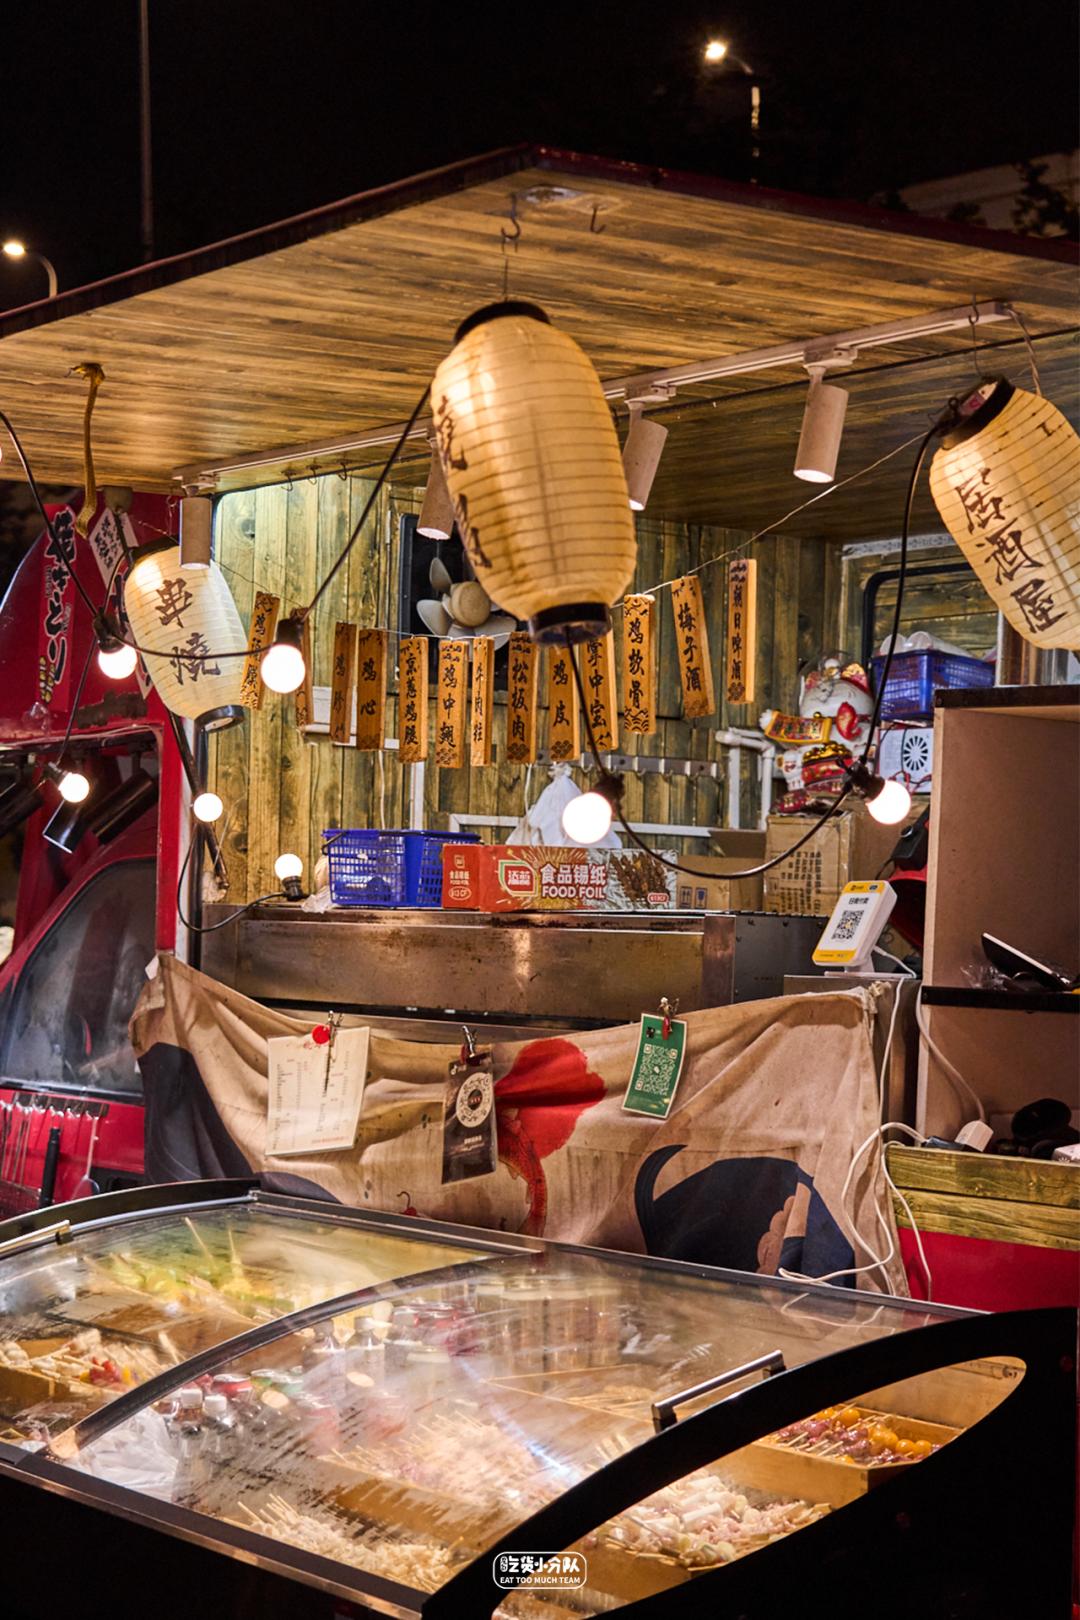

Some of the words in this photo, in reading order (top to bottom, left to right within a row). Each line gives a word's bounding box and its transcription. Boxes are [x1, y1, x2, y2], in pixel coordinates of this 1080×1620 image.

[628, 617, 645, 709] 鸡软骨
[677, 602, 702, 692] 梅子酒
[731, 585, 743, 681] 朝日啤酒
[361, 657, 377, 716] 鸡心
[439, 663, 457, 748] 鸡中翅
[552, 659, 570, 727] 鸡皮
[540, 863, 606, 885] 食品锡纸
[541, 885, 577, 898] FOOD
[578, 885, 605, 899] FOIL
